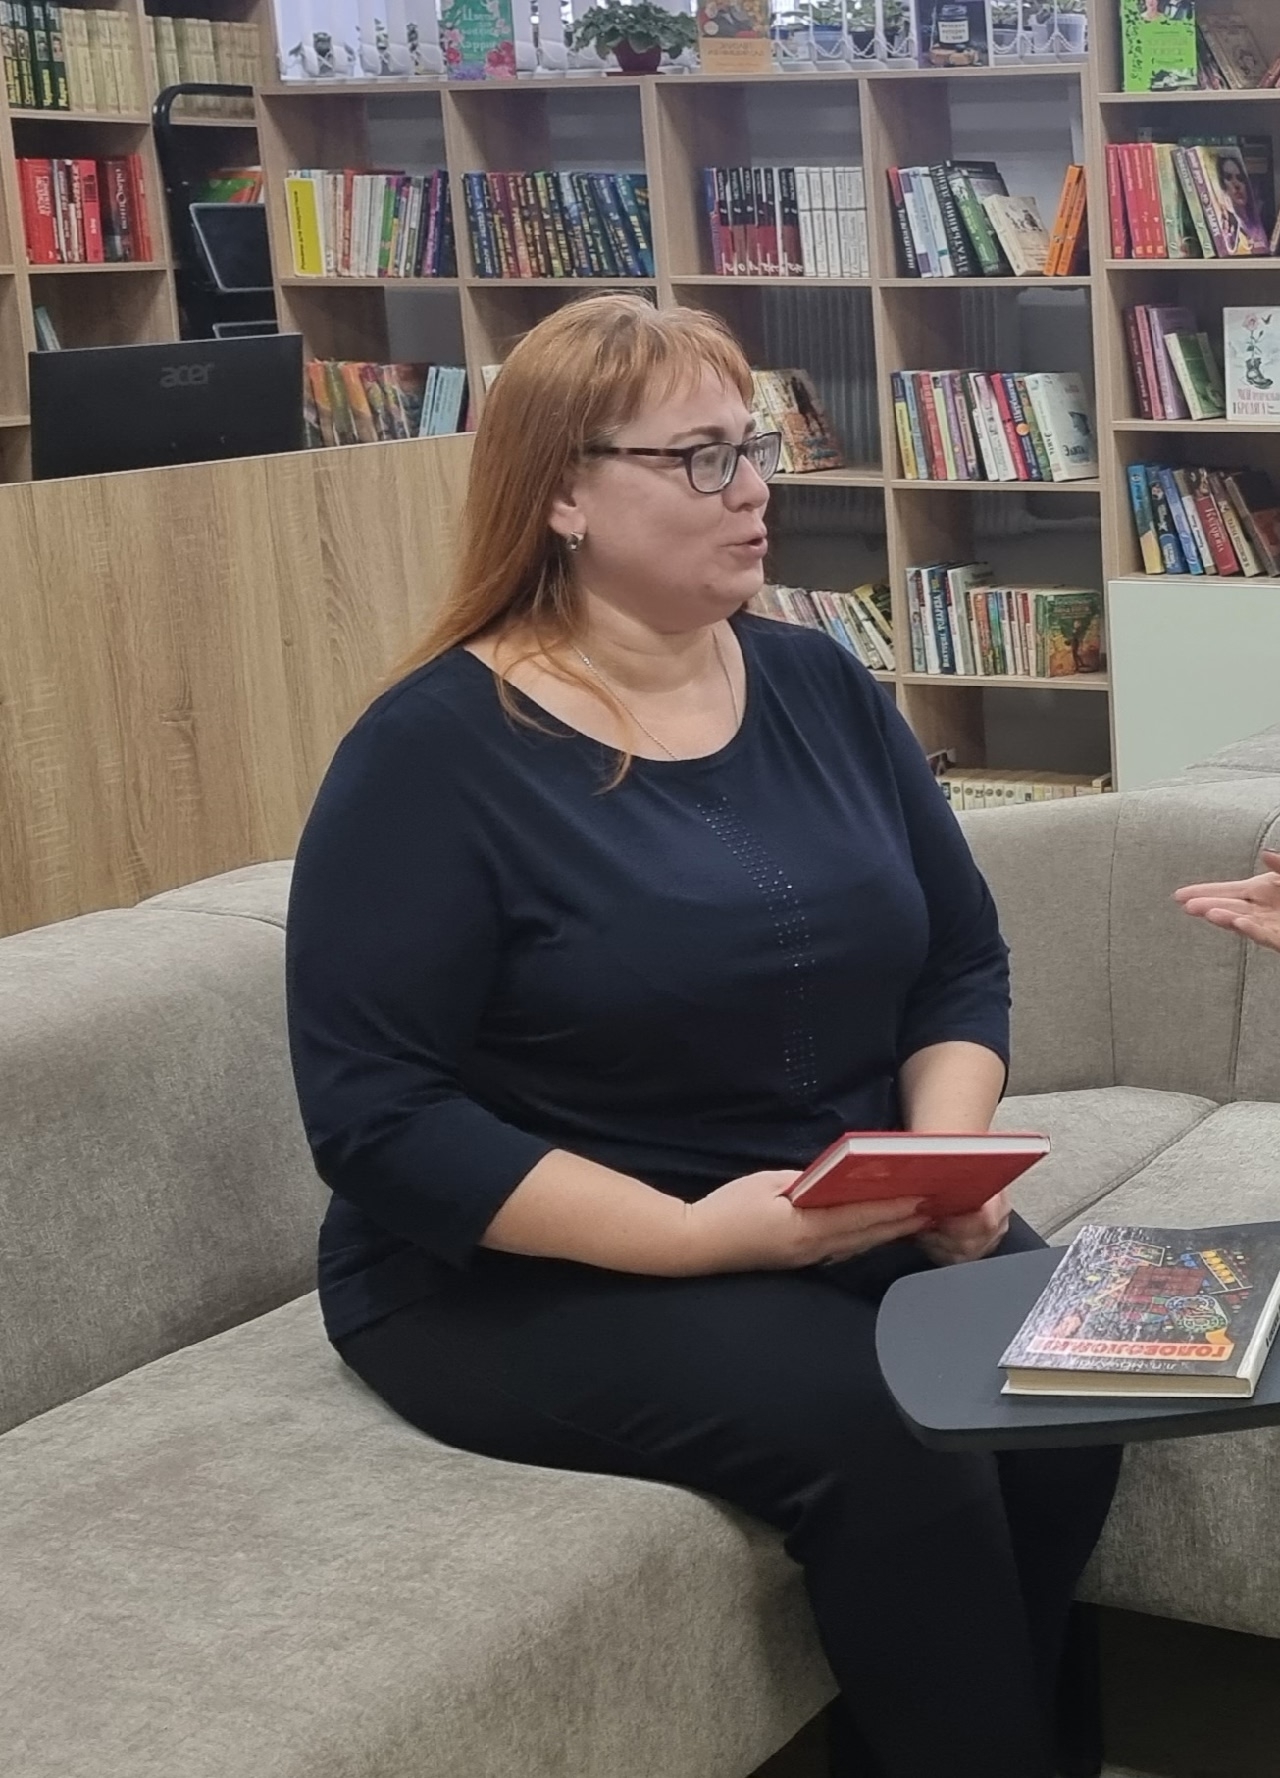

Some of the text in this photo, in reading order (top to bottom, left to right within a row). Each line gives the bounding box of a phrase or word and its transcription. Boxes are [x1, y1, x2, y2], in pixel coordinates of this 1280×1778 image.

[937, 168, 967, 261] ТАТЬЯНИН ДЕНЬ
[160, 361, 215, 388] acer
